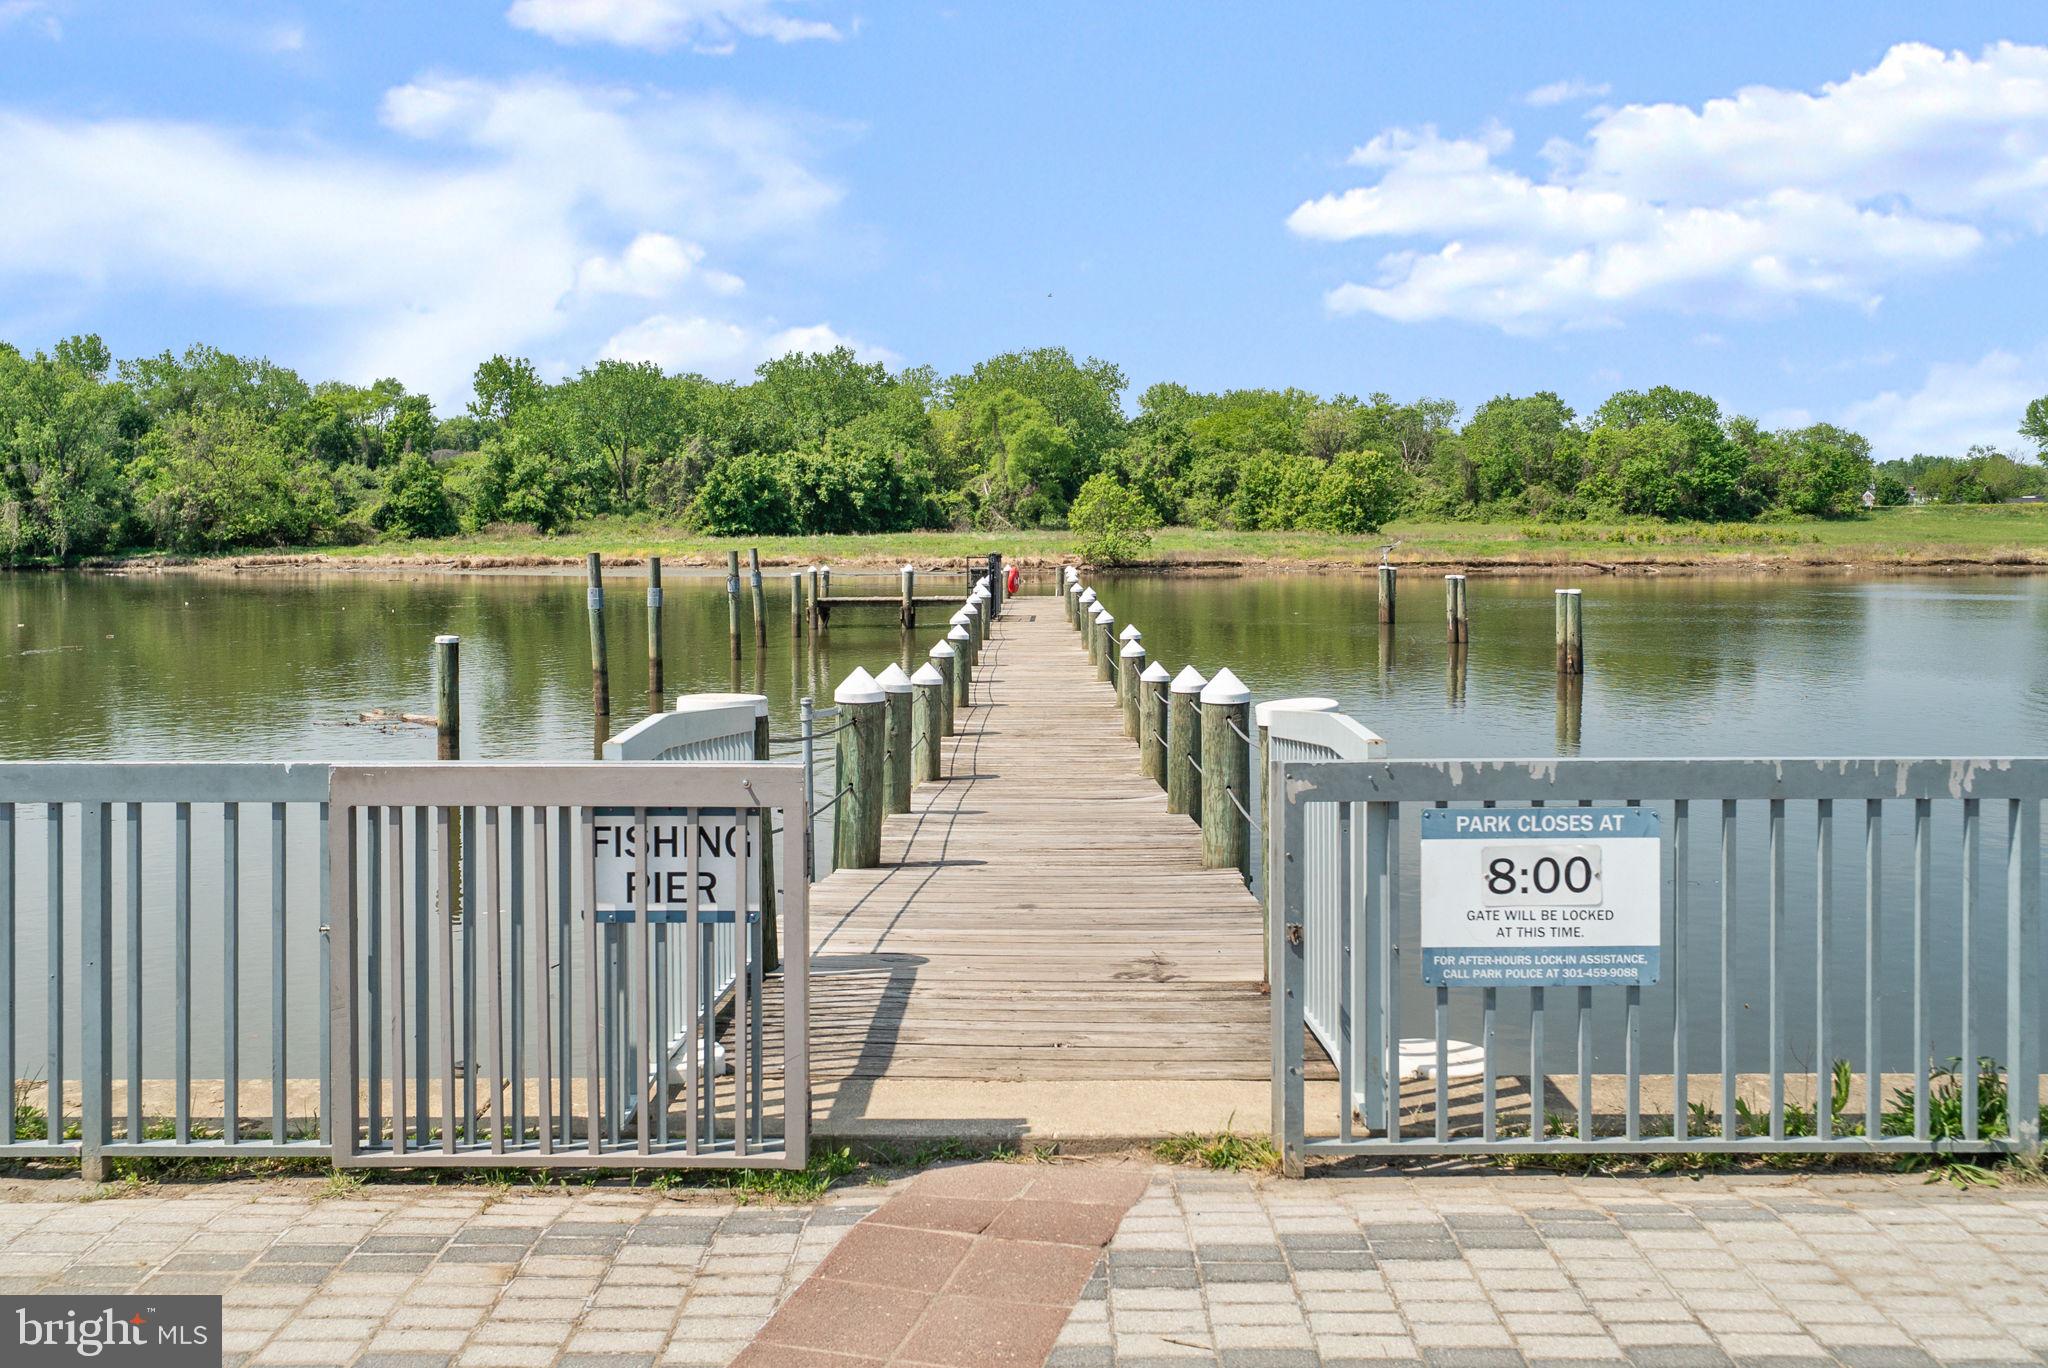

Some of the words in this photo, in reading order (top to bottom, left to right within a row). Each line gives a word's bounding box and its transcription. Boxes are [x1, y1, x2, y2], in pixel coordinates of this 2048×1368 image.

[1456, 814, 1511, 832] PARK
[1518, 815, 1593, 832] CLOSES
[1599, 814, 1625, 831] AT
[1488, 856, 1592, 894] 8:00
[626, 872, 716, 903] PIER
[1467, 910, 1500, 921] GATE
[1504, 910, 1536, 921] WILL
[1541, 910, 1557, 921] BE
[1562, 910, 1614, 920] LOCKED
[1496, 927, 1512, 937] AT
[1516, 927, 1545, 937] THIS
[1550, 927, 1584, 938] TIME.
[1434, 956, 1455, 965] FOR
[1459, 956, 1532, 965] AFTER-HOURS
[1535, 955, 1576, 965] LOCK-IN
[1443, 969, 1469, 978] CALL
[1473, 969, 1502, 978] PARK
[1506, 969, 1543, 978] POLICE
[1546, 969, 1559, 978] AT
[1562, 968, 1638, 978] 301-459-9088
